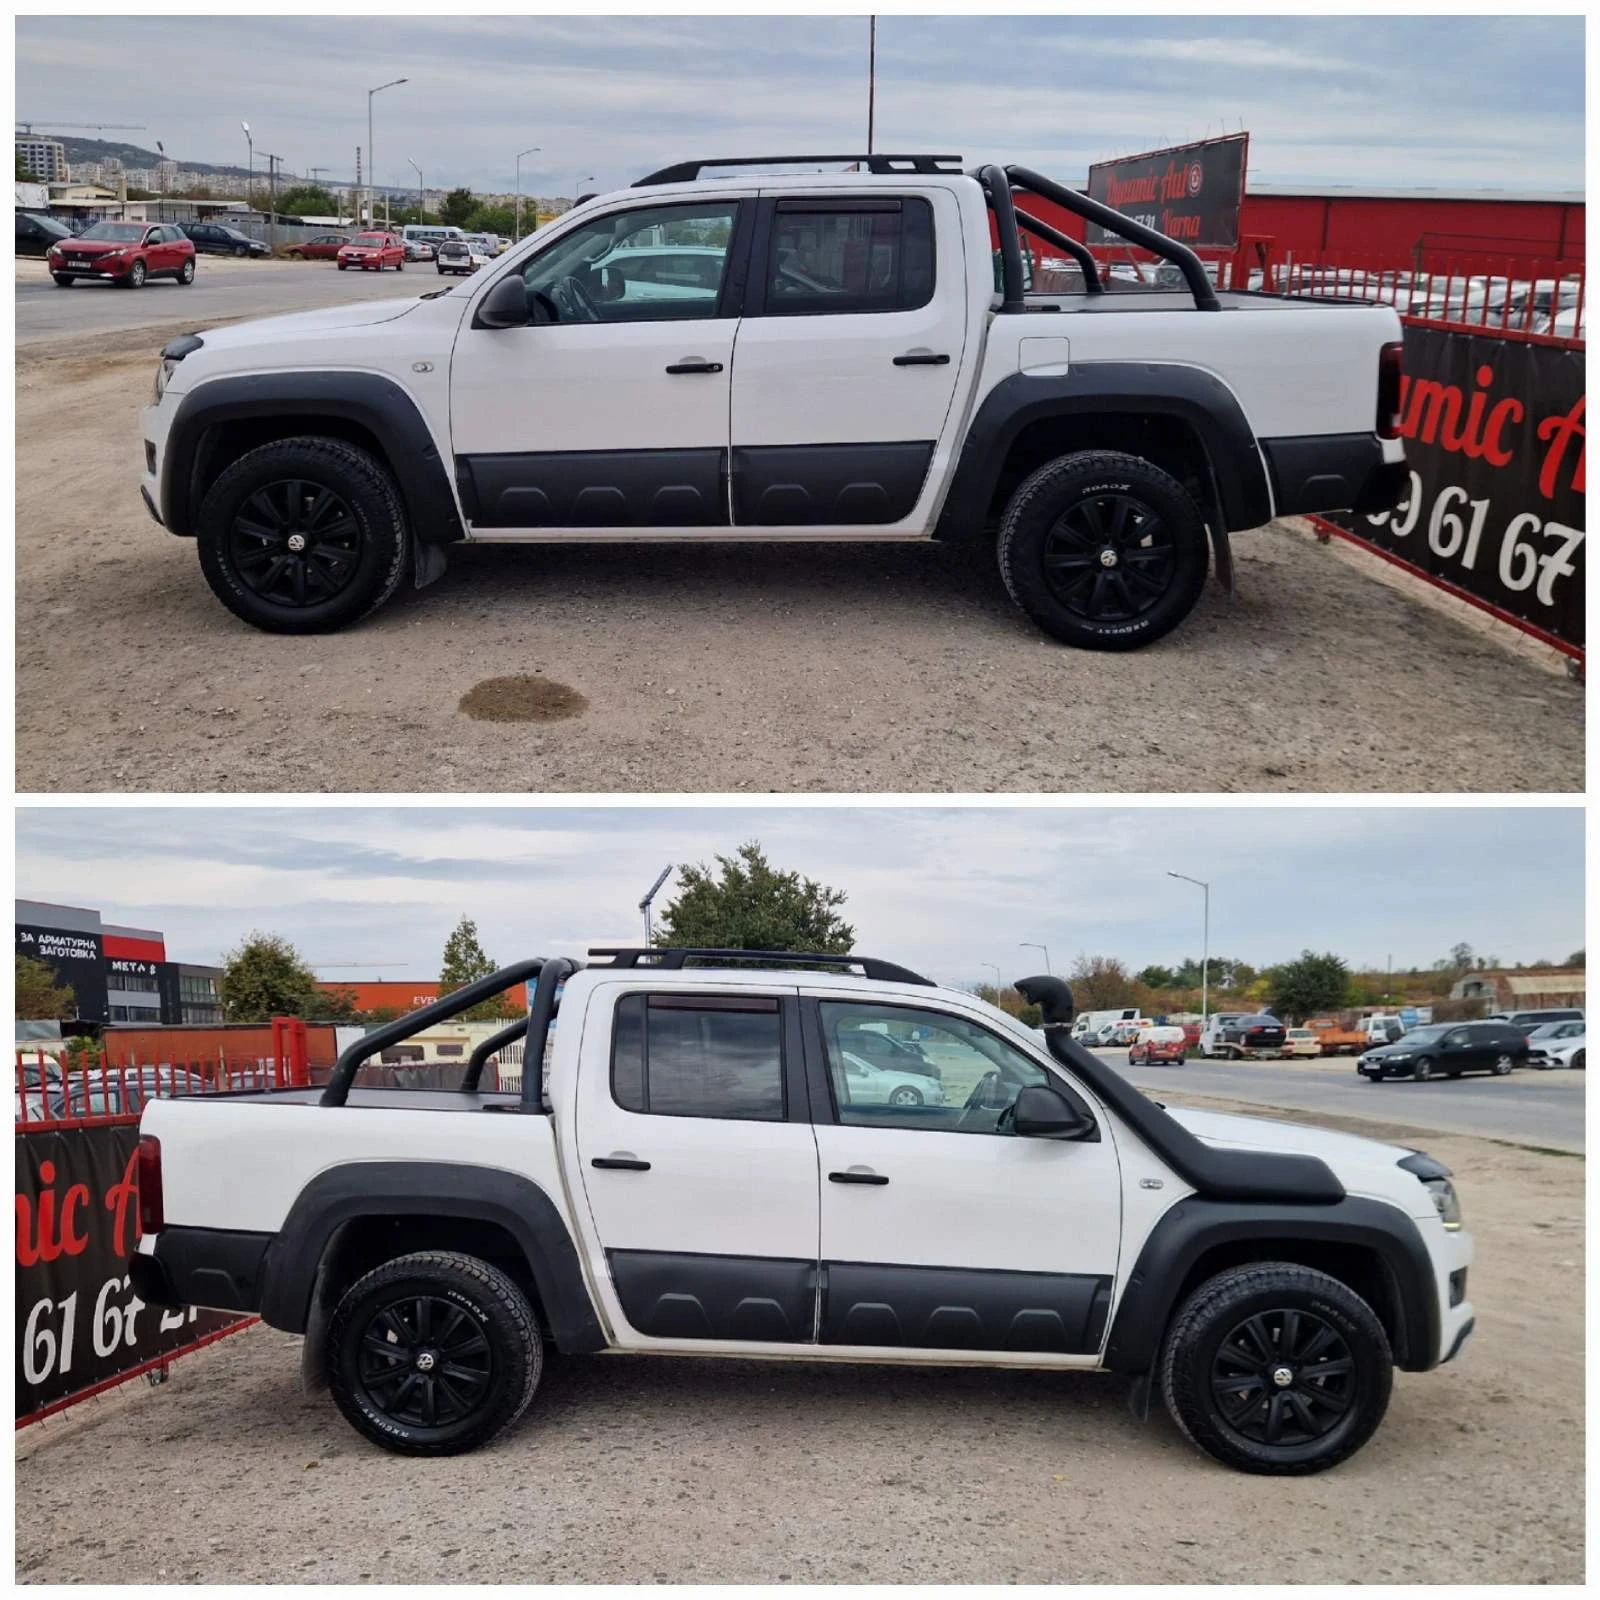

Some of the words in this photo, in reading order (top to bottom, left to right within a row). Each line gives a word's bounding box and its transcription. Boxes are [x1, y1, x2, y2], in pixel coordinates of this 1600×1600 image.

[1428, 486, 1490, 570] 61
[1499, 512, 1586, 606] 67
[20, 932, 34, 943] ЗА
[38, 934, 97, 950] АРМАТУРНА
[40, 944, 97, 960] ЗАГОТОВКА
[23, 1290, 77, 1385] 61
